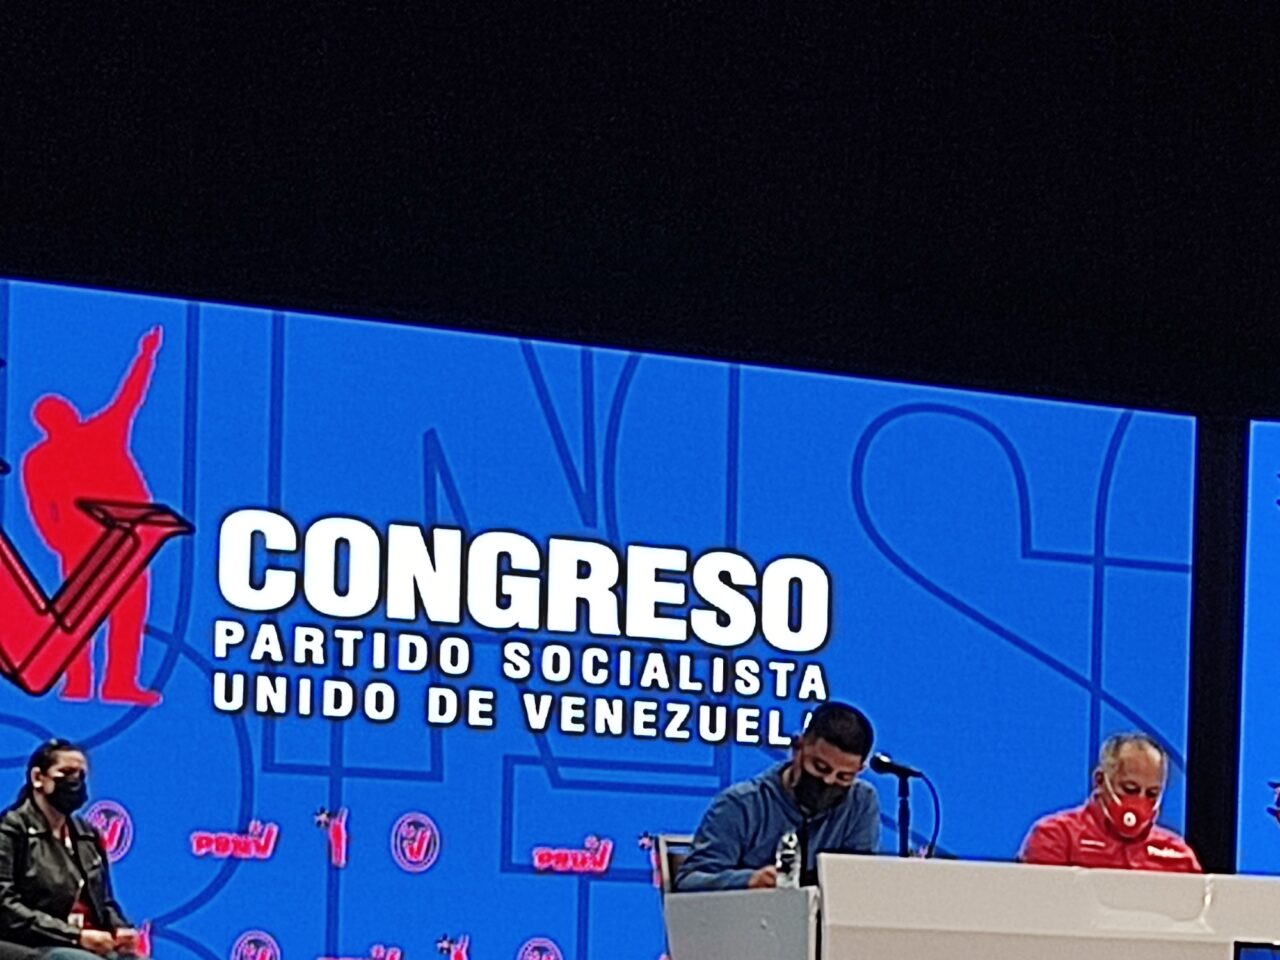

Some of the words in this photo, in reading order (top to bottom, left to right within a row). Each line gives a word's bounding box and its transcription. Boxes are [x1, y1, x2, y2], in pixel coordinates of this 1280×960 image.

[218, 508, 829, 652] CONGRESO
[214, 620, 470, 676] PARTIDO
[503, 642, 827, 700] SOCIALISTA
[213, 672, 395, 720] UNIDO
[428, 687, 495, 726] DE
[523, 693, 813, 745] VENEZUEL
